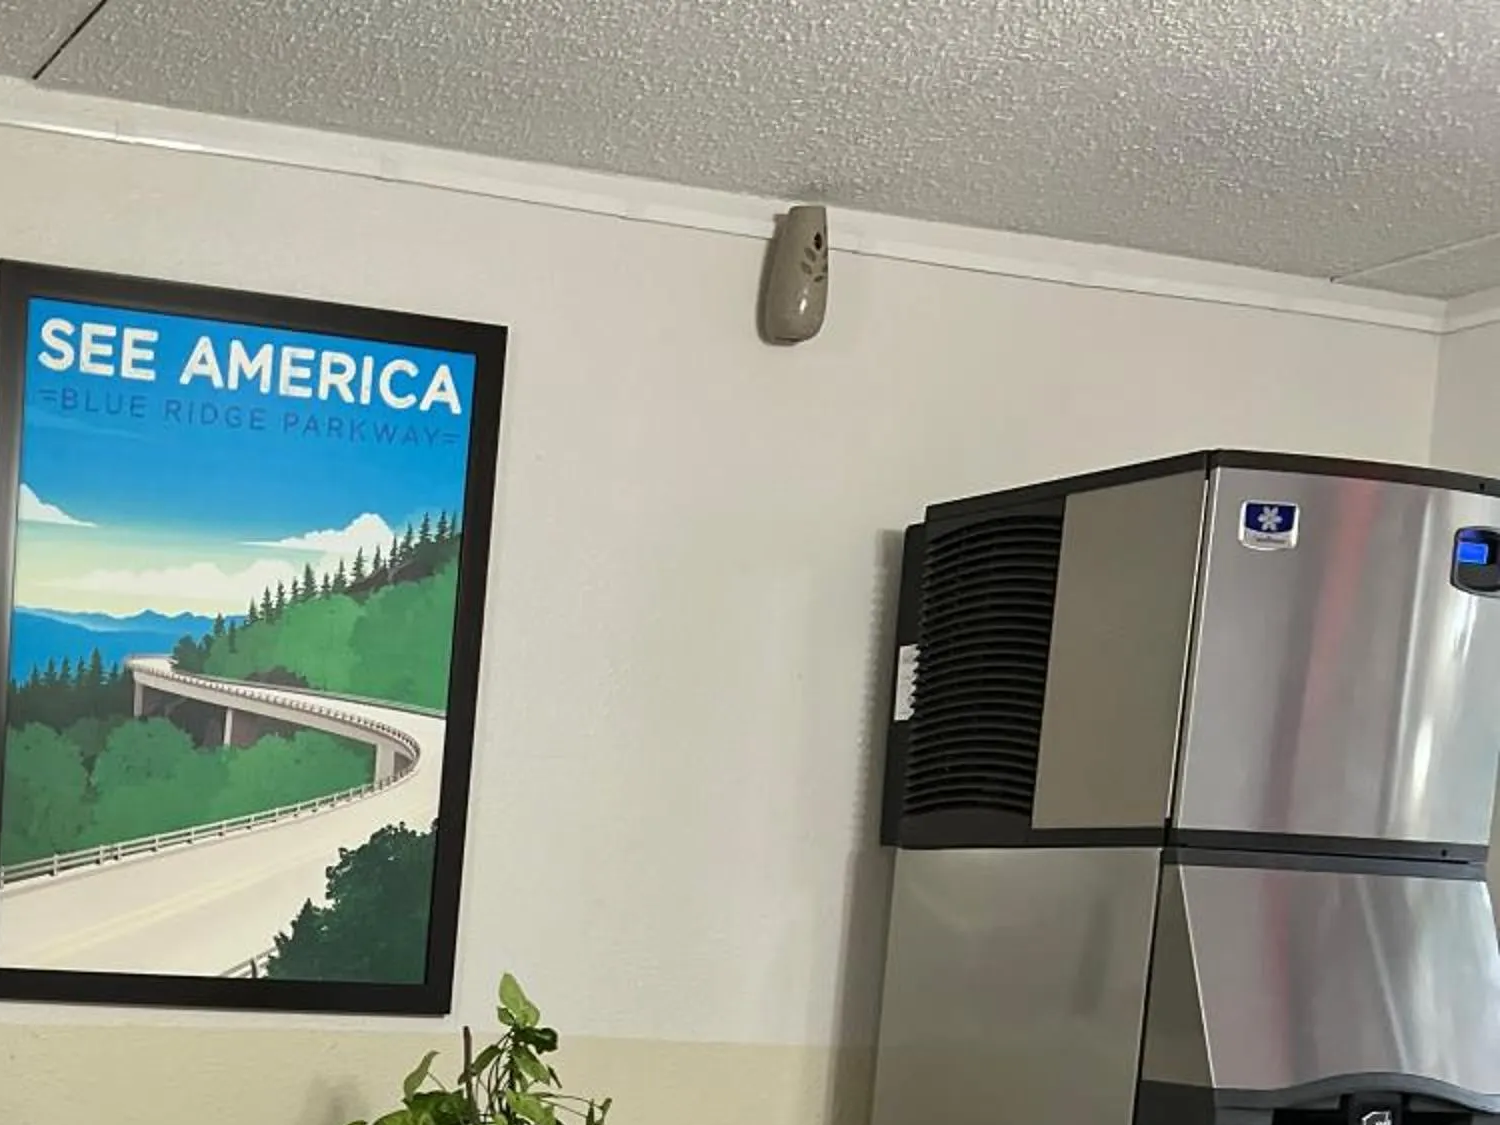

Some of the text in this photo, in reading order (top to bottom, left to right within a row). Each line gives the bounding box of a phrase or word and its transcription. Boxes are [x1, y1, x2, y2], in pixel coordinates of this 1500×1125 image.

[38, 318, 462, 414] SEE AMERICA
[61, 387, 441, 446] BLUE RIDGE PARKWAY
